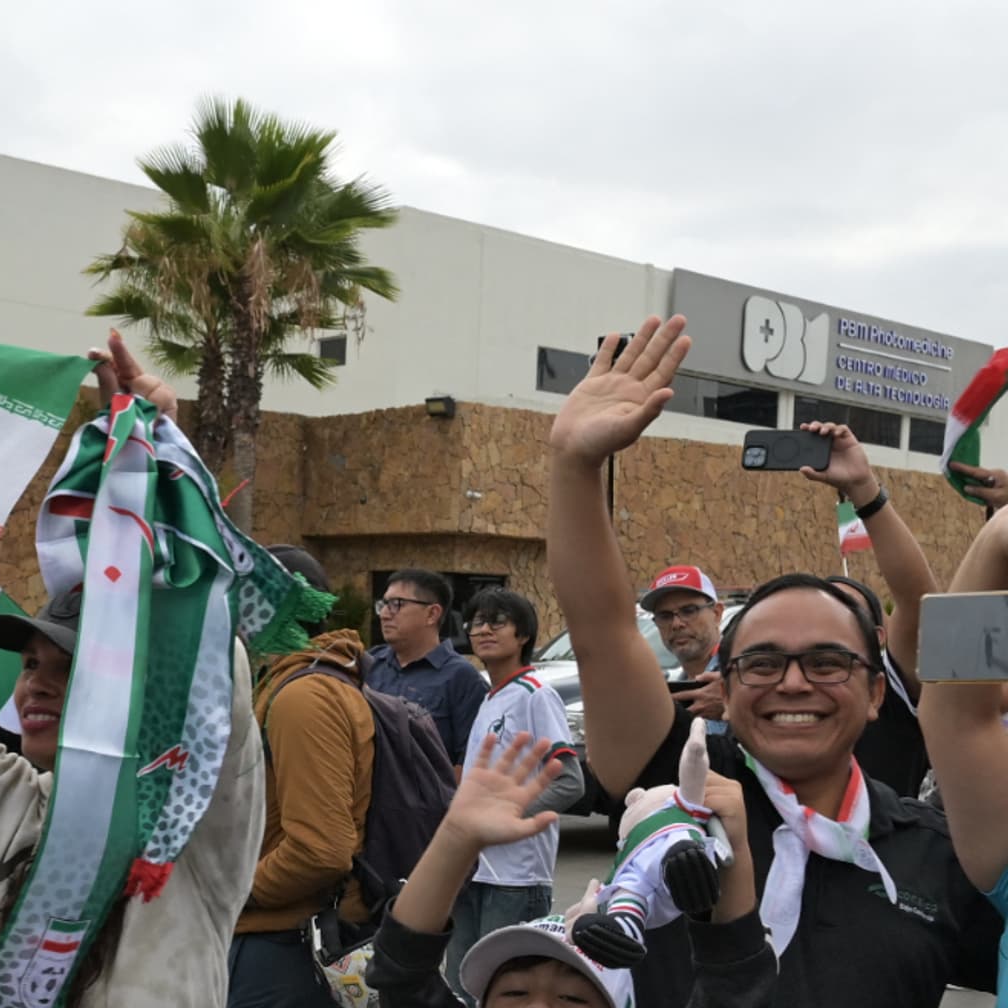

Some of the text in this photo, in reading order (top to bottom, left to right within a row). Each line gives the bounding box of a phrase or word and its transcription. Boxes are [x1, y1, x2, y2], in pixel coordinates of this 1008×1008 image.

[868, 325, 953, 360] Photomedicine
[835, 376, 851, 392] DE
[853, 379, 882, 397] ALTA
